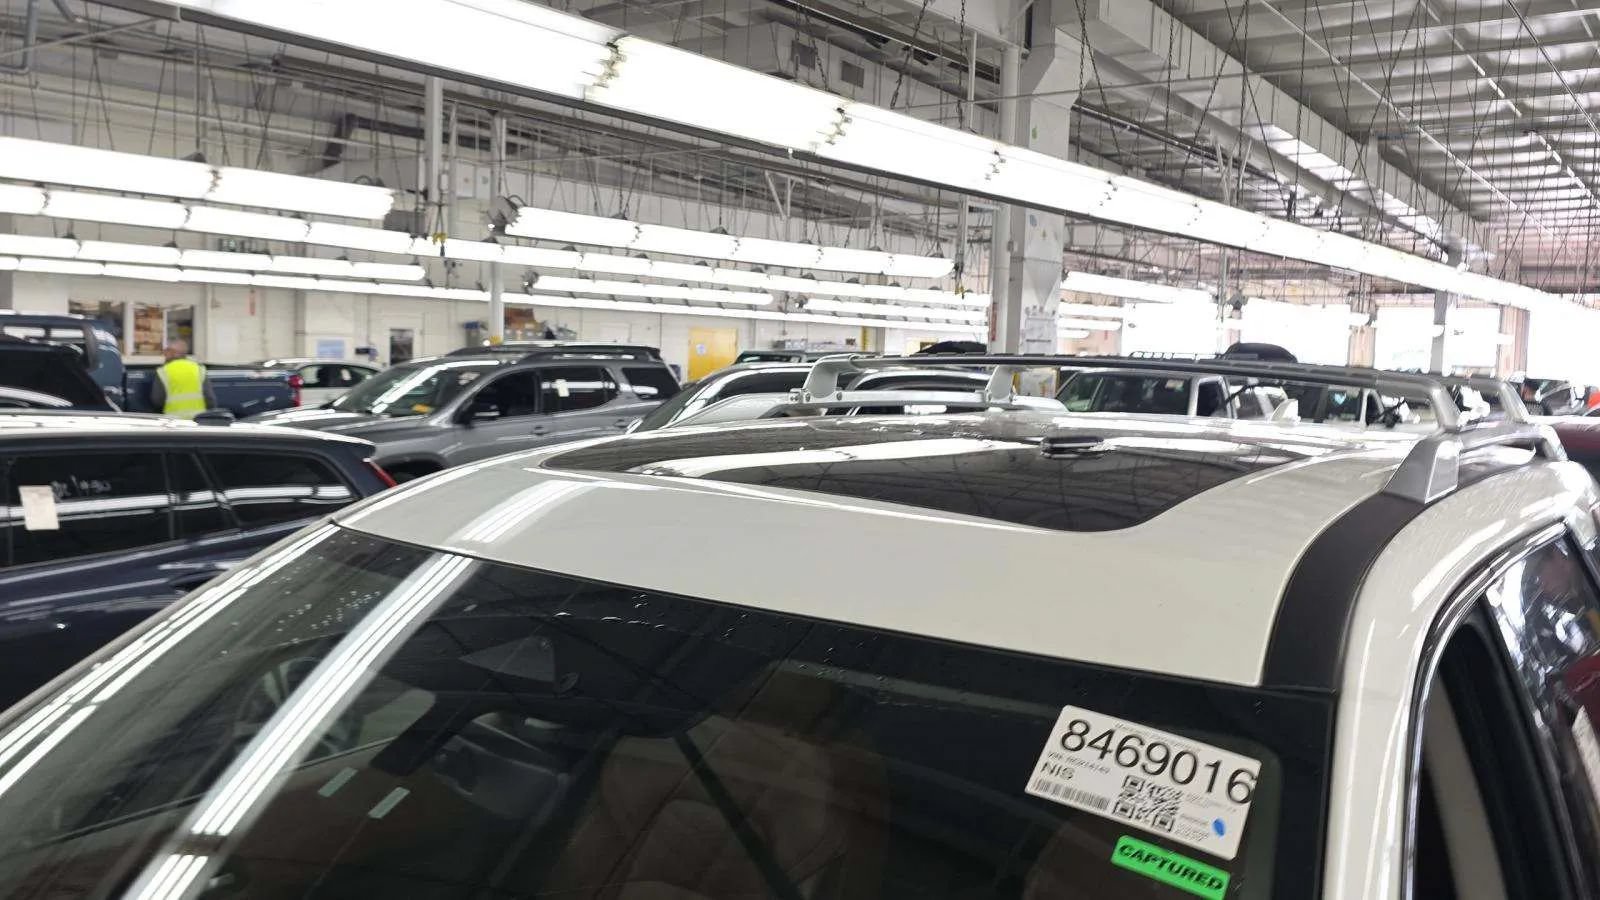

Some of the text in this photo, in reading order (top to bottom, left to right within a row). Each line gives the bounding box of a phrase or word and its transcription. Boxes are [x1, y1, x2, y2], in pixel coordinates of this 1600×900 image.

[1040, 762, 1074, 780] NIS
[1061, 719, 1257, 804] 8469016
[1119, 844, 1223, 891] CAPTURED
